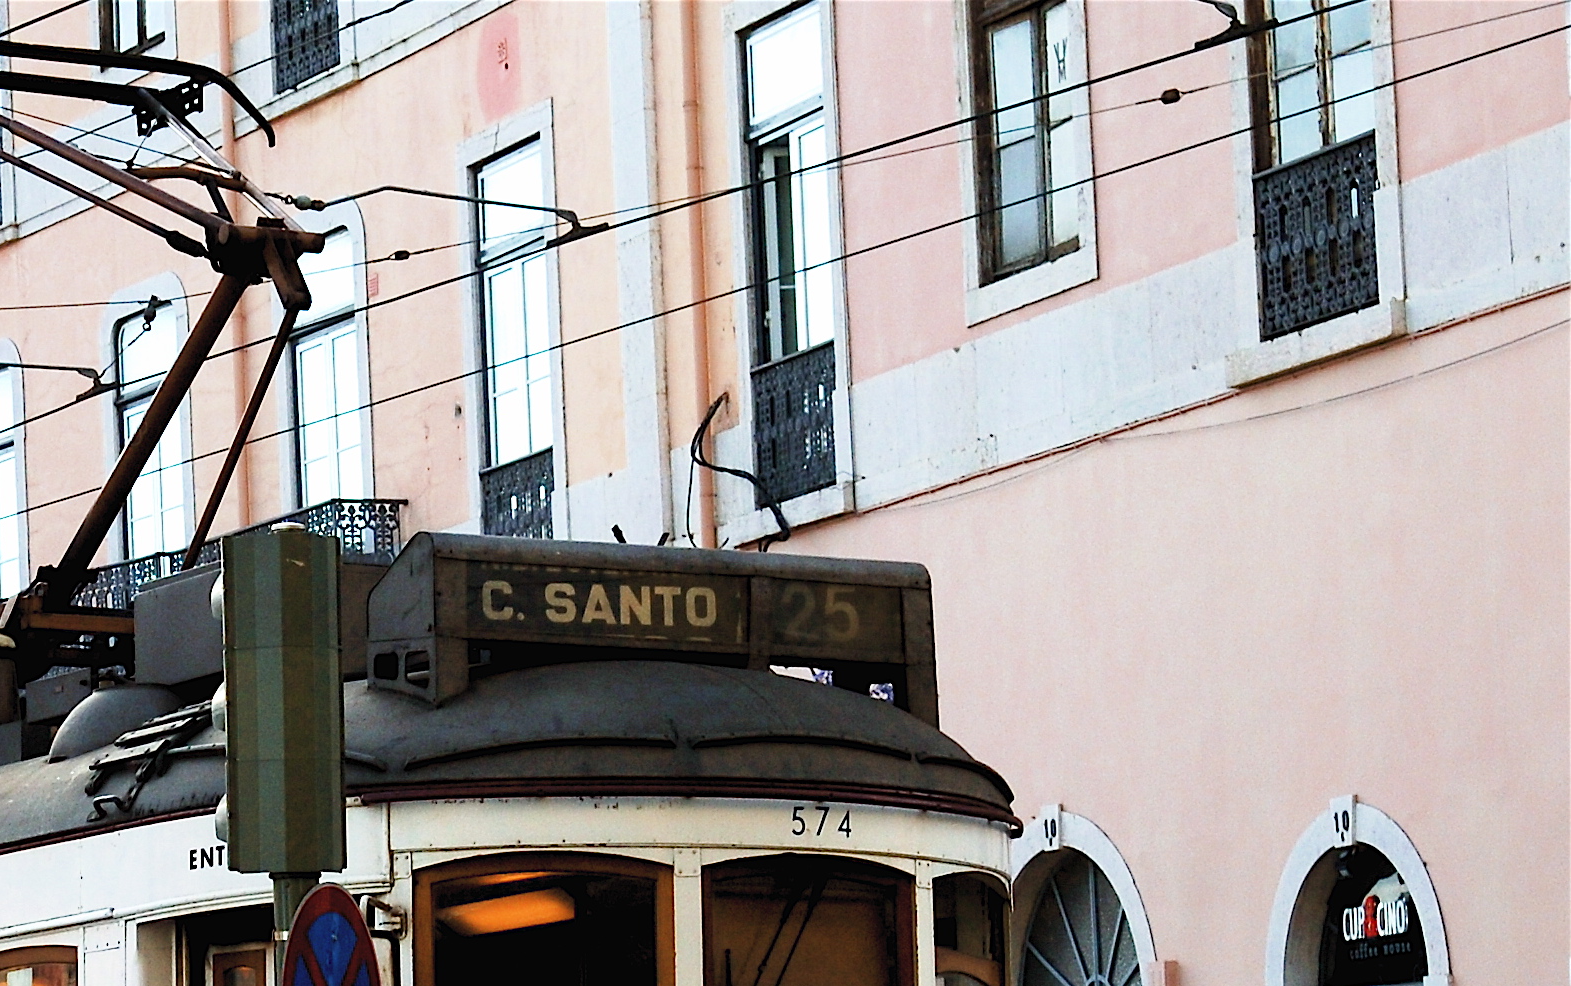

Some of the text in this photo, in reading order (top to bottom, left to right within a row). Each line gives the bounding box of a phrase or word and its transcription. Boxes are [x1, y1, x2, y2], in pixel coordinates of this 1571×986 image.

[481, 579, 718, 628] C. SANTO
[781, 583, 861, 642] 25
[791, 805, 852, 838] 574
[189, 844, 226, 871] ENT
